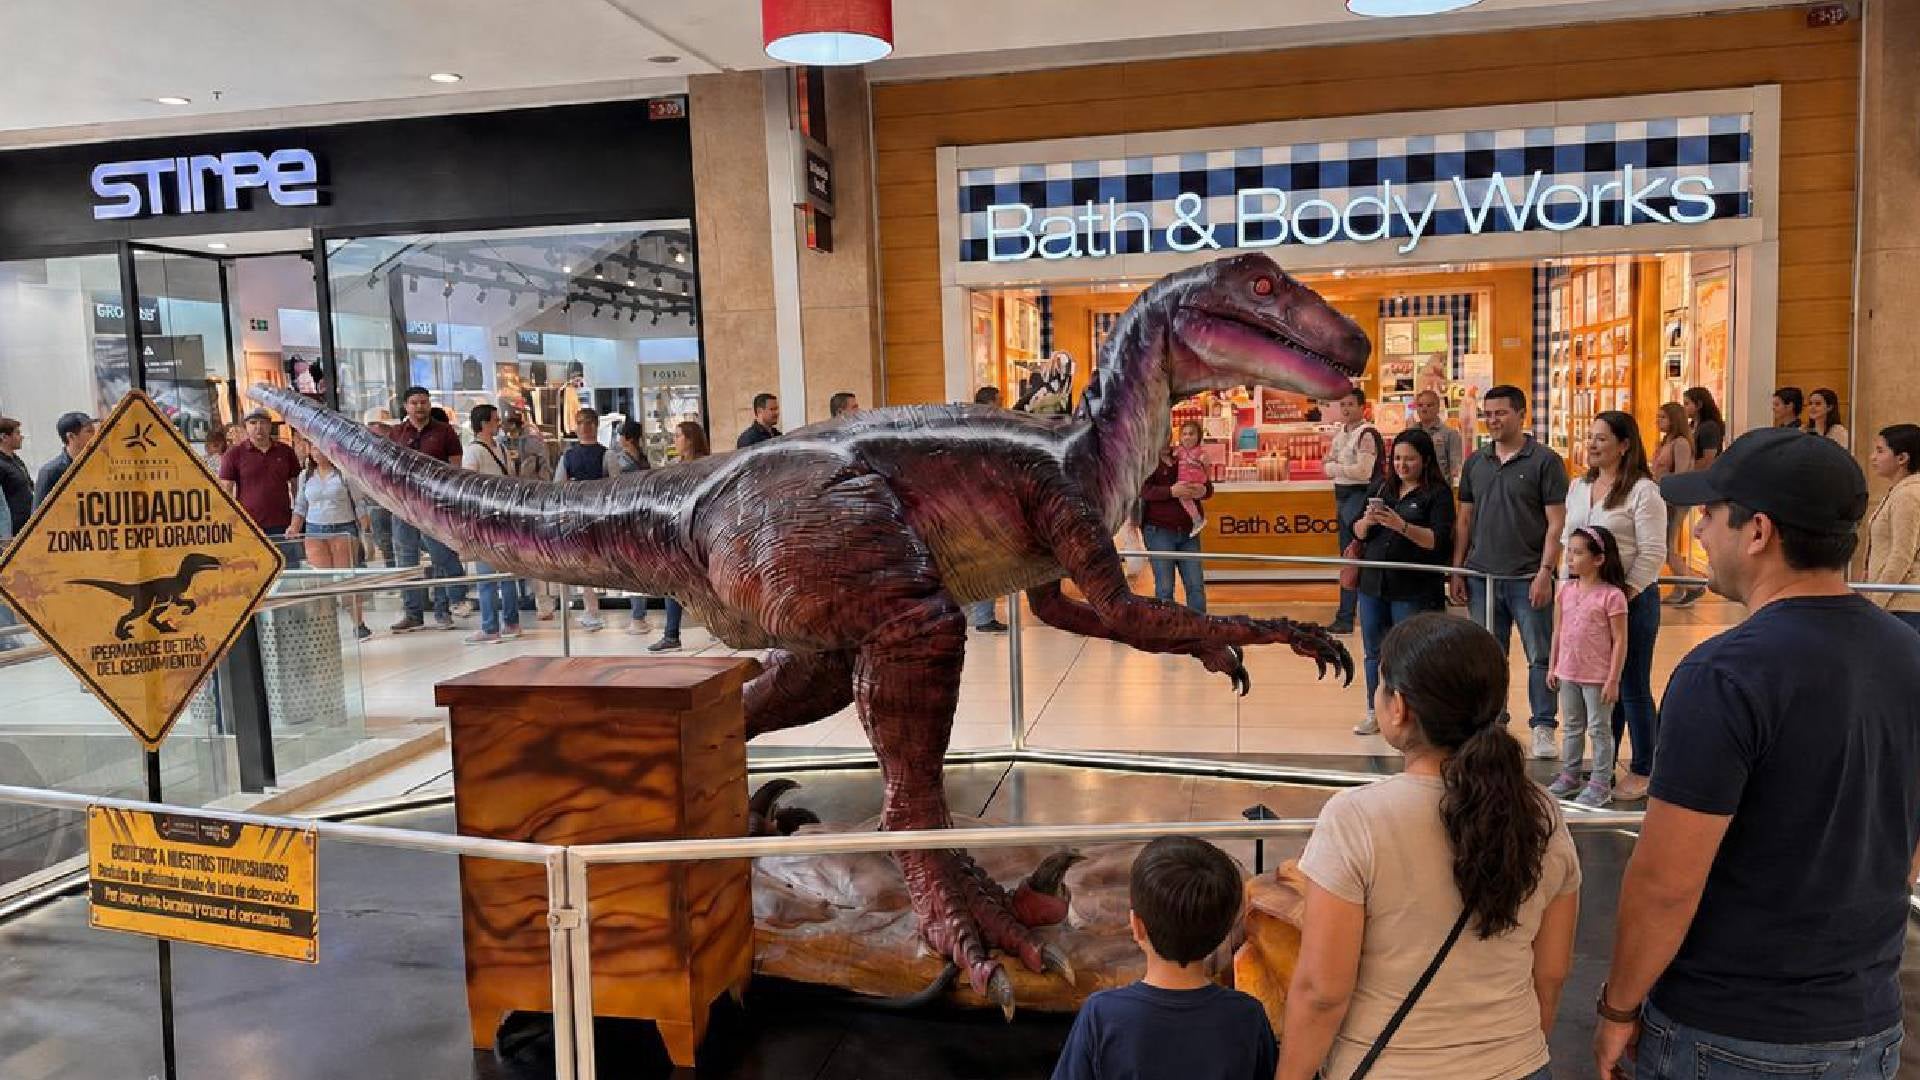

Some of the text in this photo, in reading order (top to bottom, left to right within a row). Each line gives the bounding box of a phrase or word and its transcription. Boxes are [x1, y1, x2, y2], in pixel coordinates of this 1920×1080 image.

[987, 163, 1716, 262] Bath & Body Works
[78, 490, 212, 526] ¡CUIDADO!
[1220, 515, 1270, 534] Bath
[1273, 516, 1292, 534] &
[47, 521, 233, 553] ZONA DE EXPLORACIÓN
